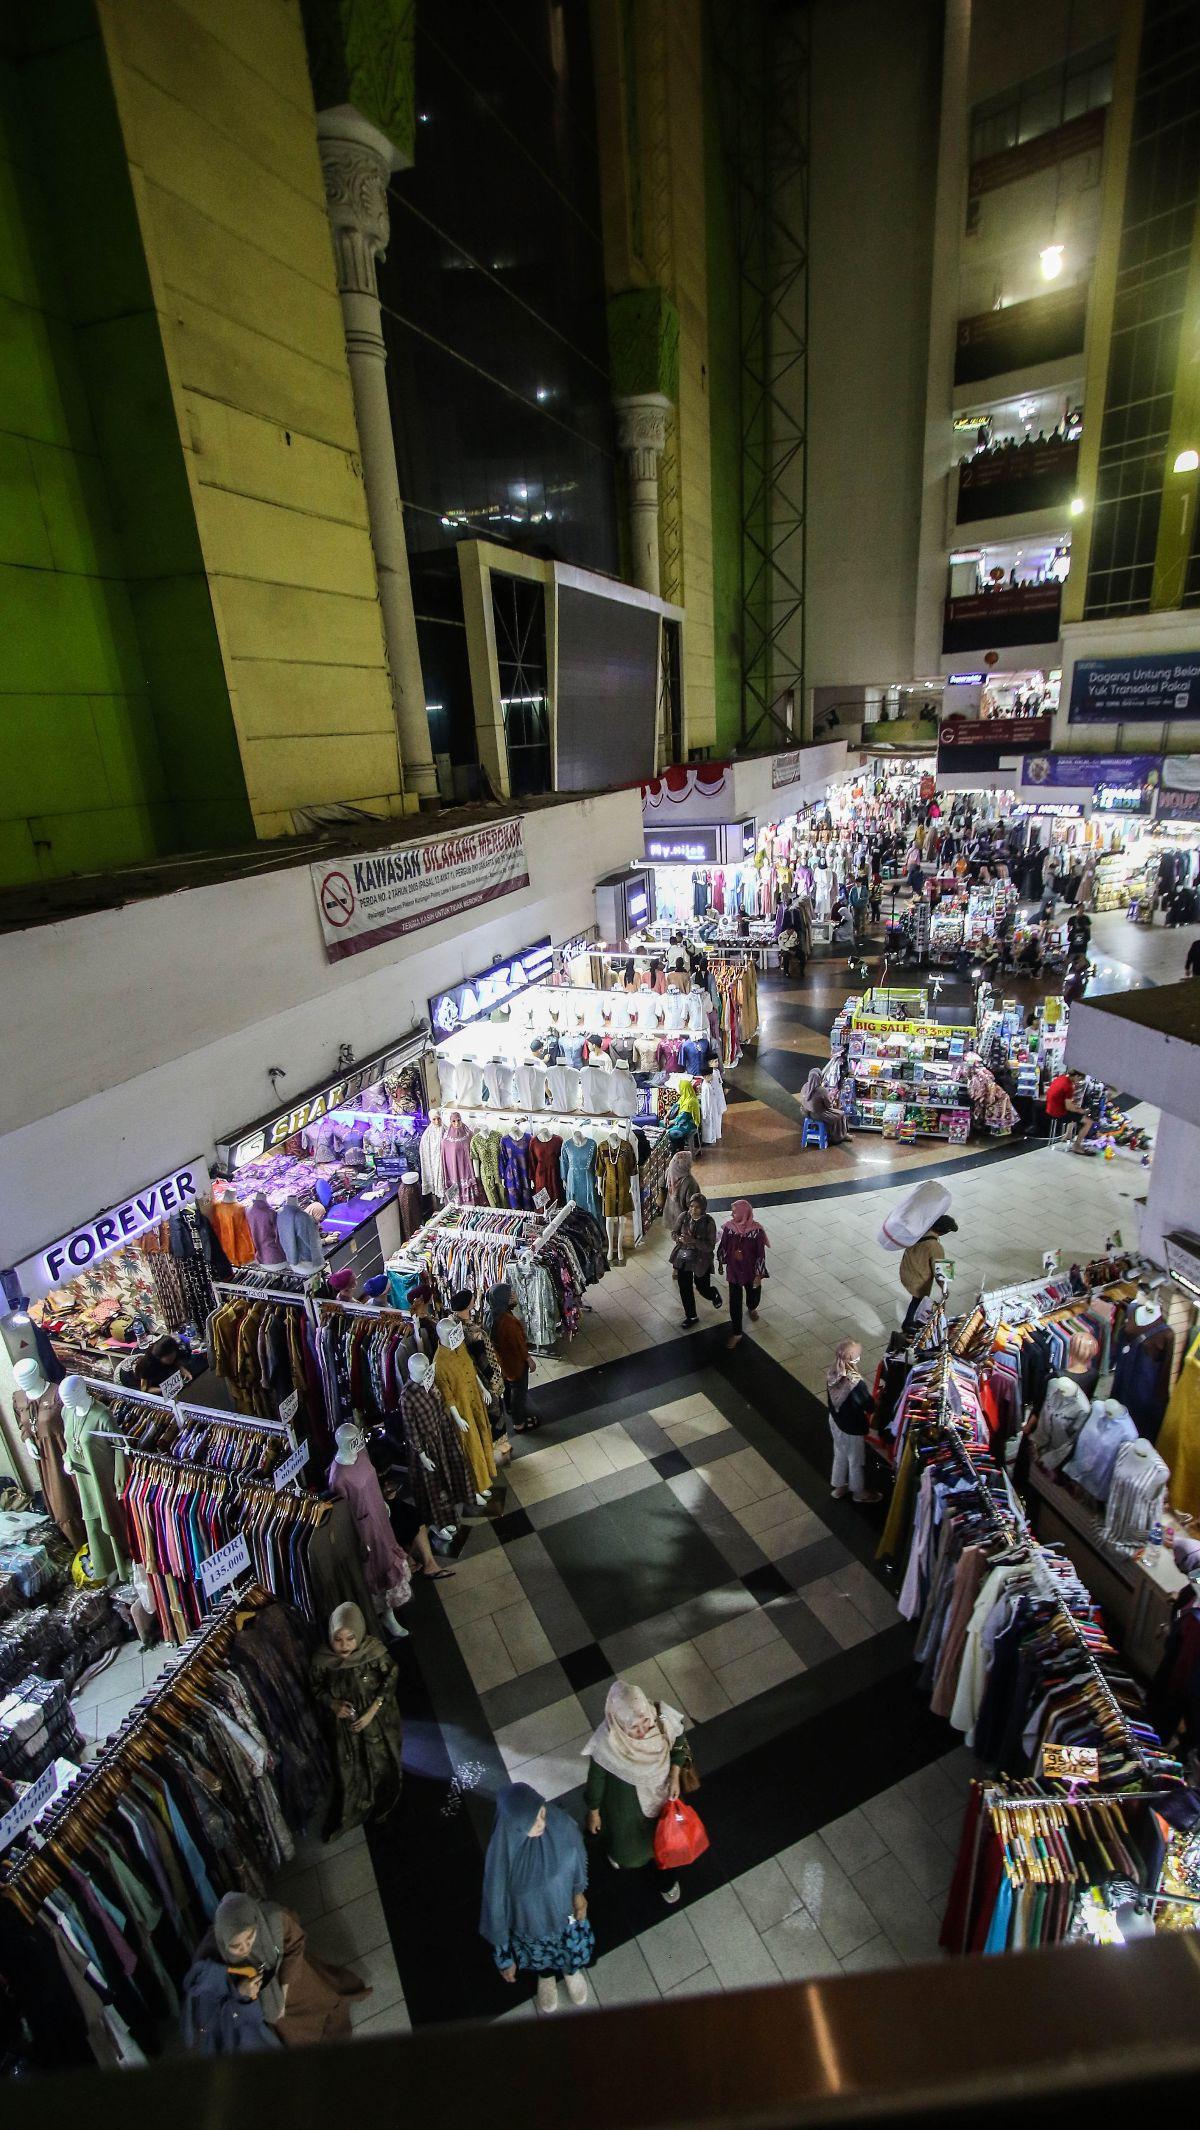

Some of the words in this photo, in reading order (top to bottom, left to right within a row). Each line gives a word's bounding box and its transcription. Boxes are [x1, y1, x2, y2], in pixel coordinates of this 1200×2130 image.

[1088, 671, 1131, 684] Dagang
[1133, 669, 1172, 681] Untung
[1088, 685, 1108, 695] Yuk
[1110, 682, 1159, 694] Transaksi
[1161, 680, 1191, 692] Pakai
[940, 728, 955, 743] G
[353, 849, 421, 894] KAWASAN
[422, 835, 477, 874] DILARANG
[478, 821, 522, 858] MEROKOK
[401, 917, 418, 932] TERIMA
[418, 912, 435, 926] KASIH
[435, 907, 451, 919] UNTUK
[450, 901, 463, 912] TIDAK
[463, 894, 483, 906] MEROKOK
[855, 1021, 876, 1032] BIG
[880, 1023, 911, 1033] SALE
[45, 1171, 197, 1282] FOREVER
[201, 1534, 244, 1574] IMPORT
[210, 1551, 245, 1583] 135.000
